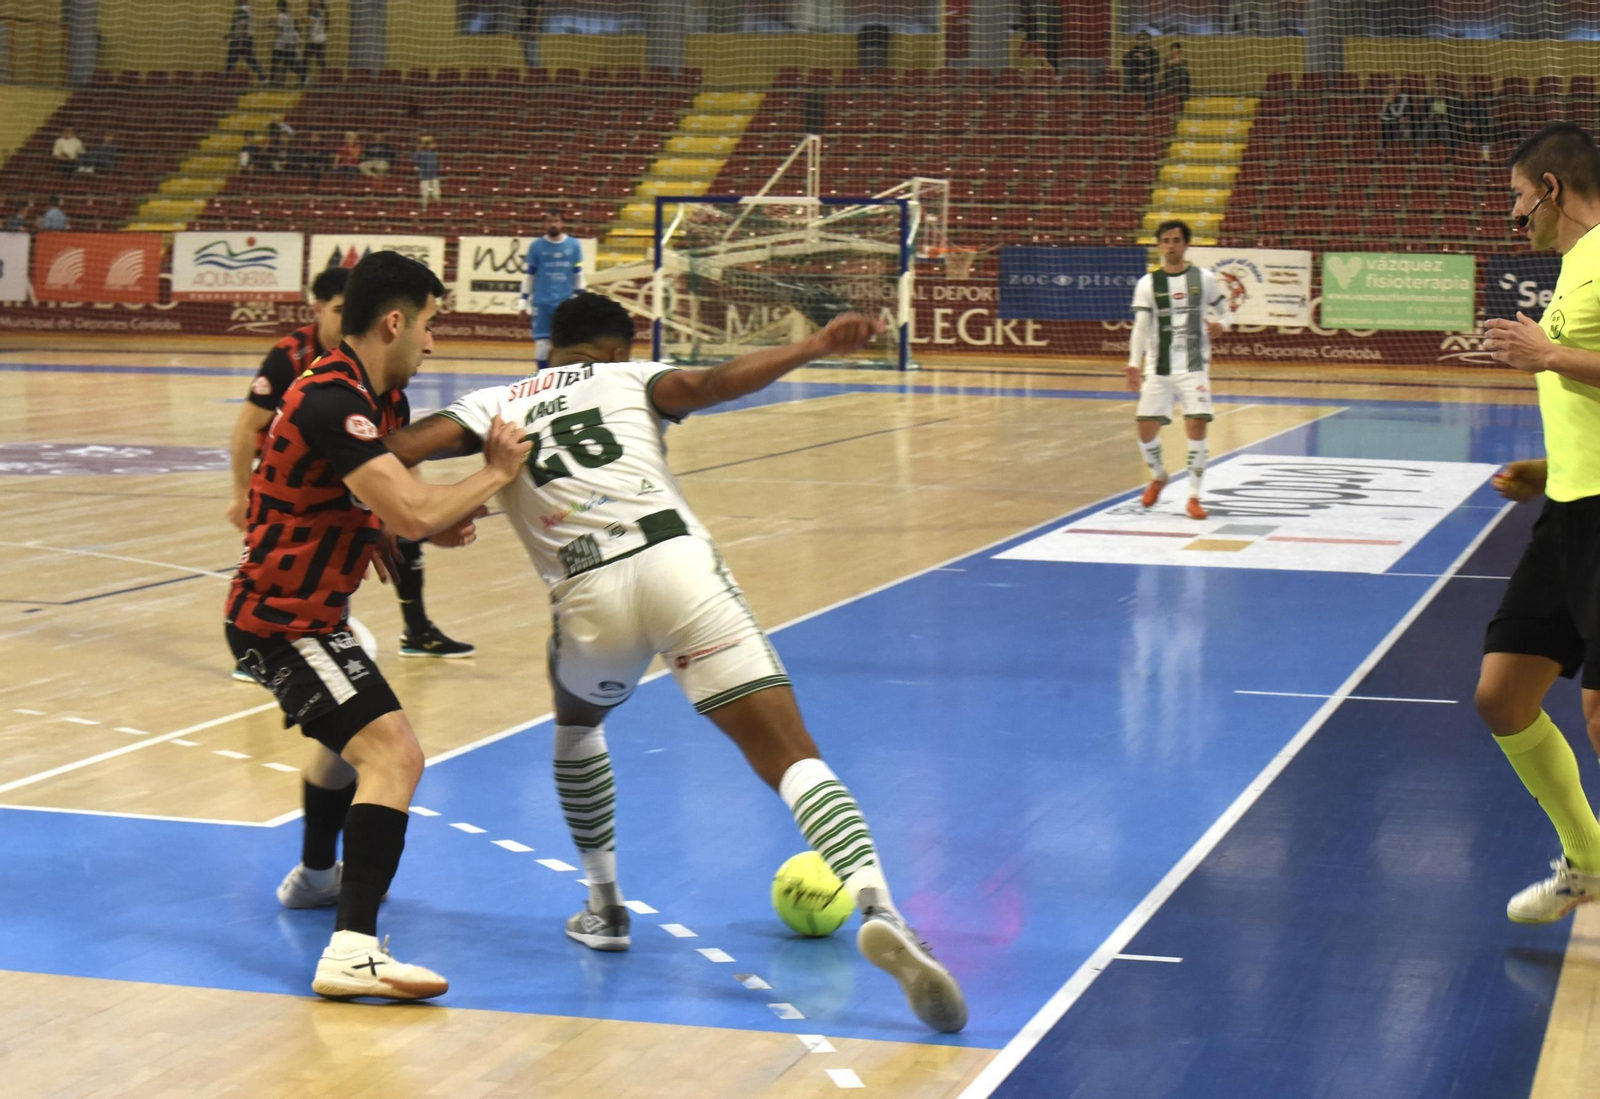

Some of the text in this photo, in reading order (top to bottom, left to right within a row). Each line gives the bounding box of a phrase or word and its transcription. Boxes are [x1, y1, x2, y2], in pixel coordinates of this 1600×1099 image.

[1365, 257, 1443, 273] vázquez
[1365, 273, 1470, 291] fisioterapia
[1253, 344, 1318, 359] Deportes
